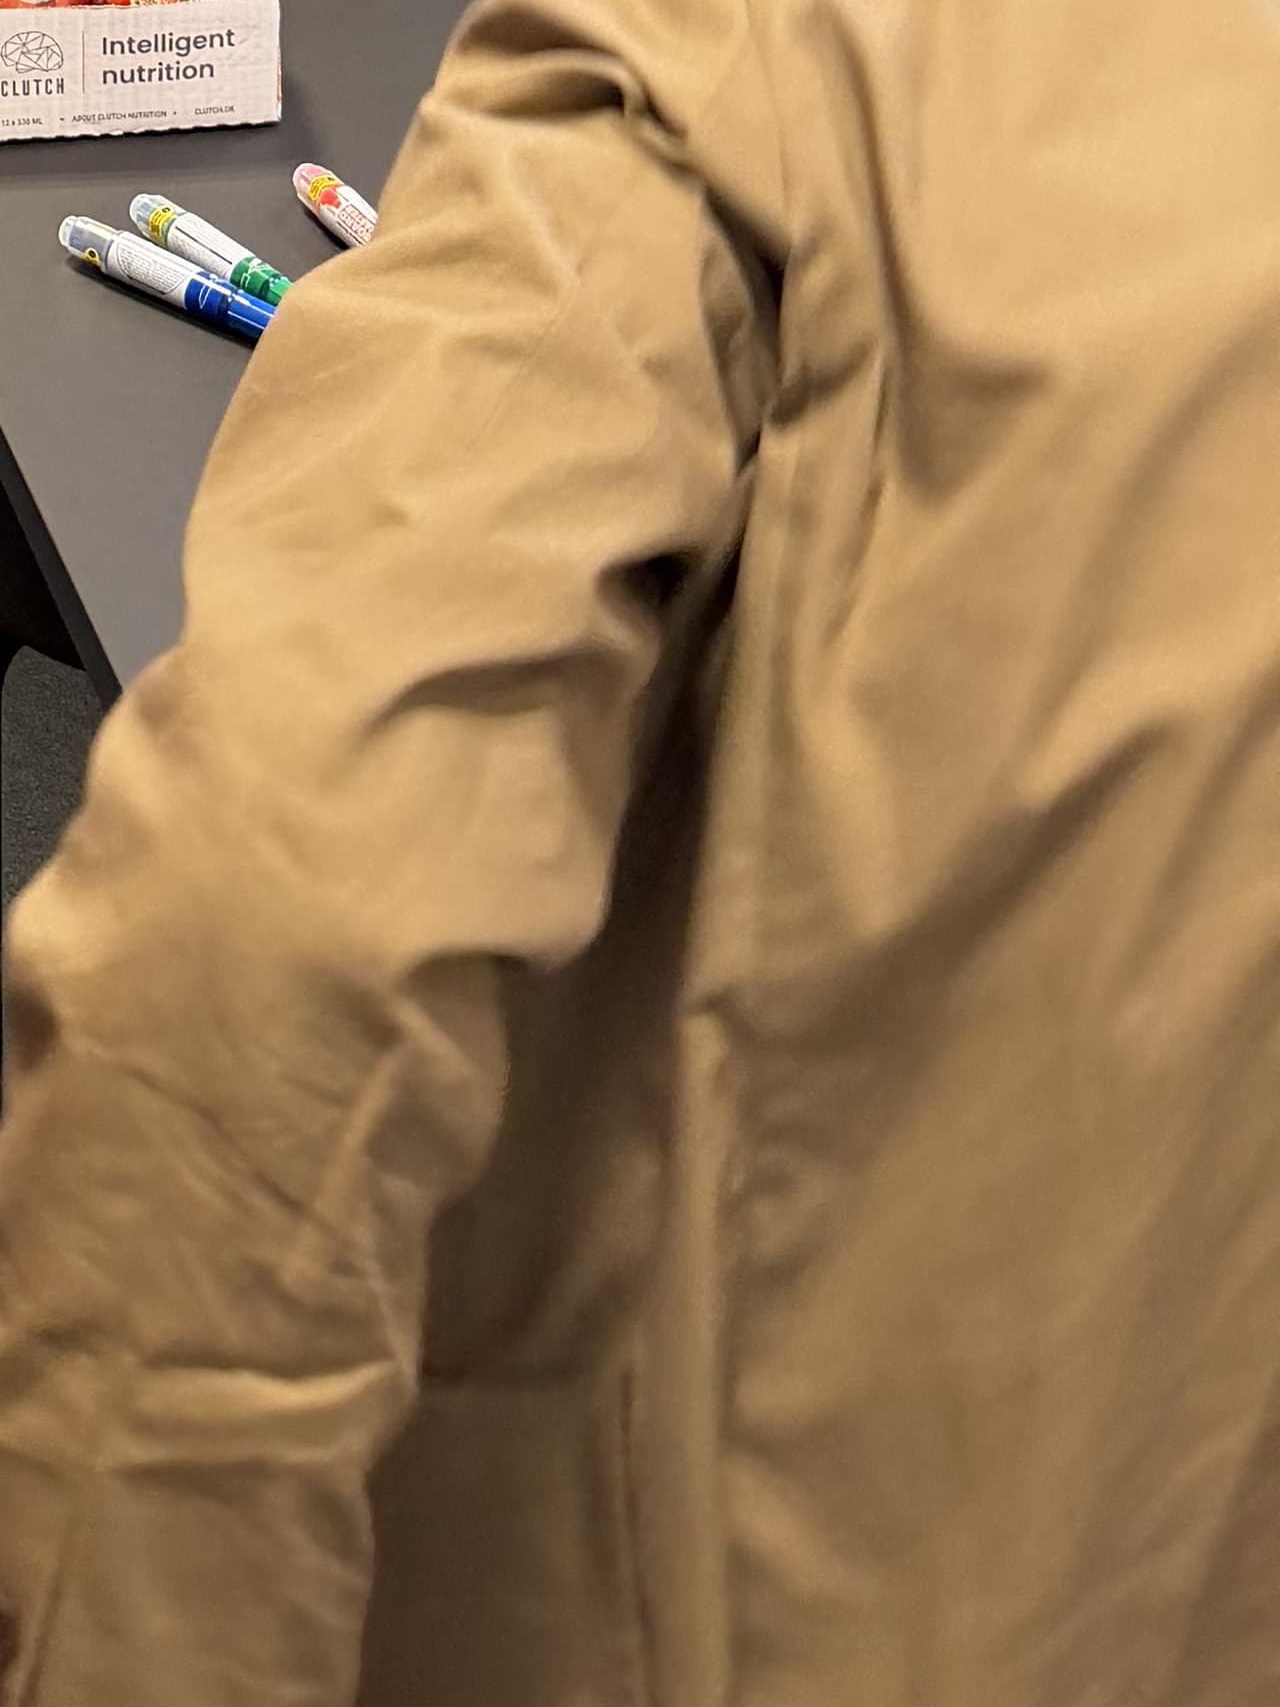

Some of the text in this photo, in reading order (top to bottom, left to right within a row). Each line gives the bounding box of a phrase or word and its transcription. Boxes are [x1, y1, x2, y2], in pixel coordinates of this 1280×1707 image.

[101, 28, 237, 58] Intelligent
[102, 60, 215, 86] nutrition
[0, 77, 65, 98] CLUTCH
